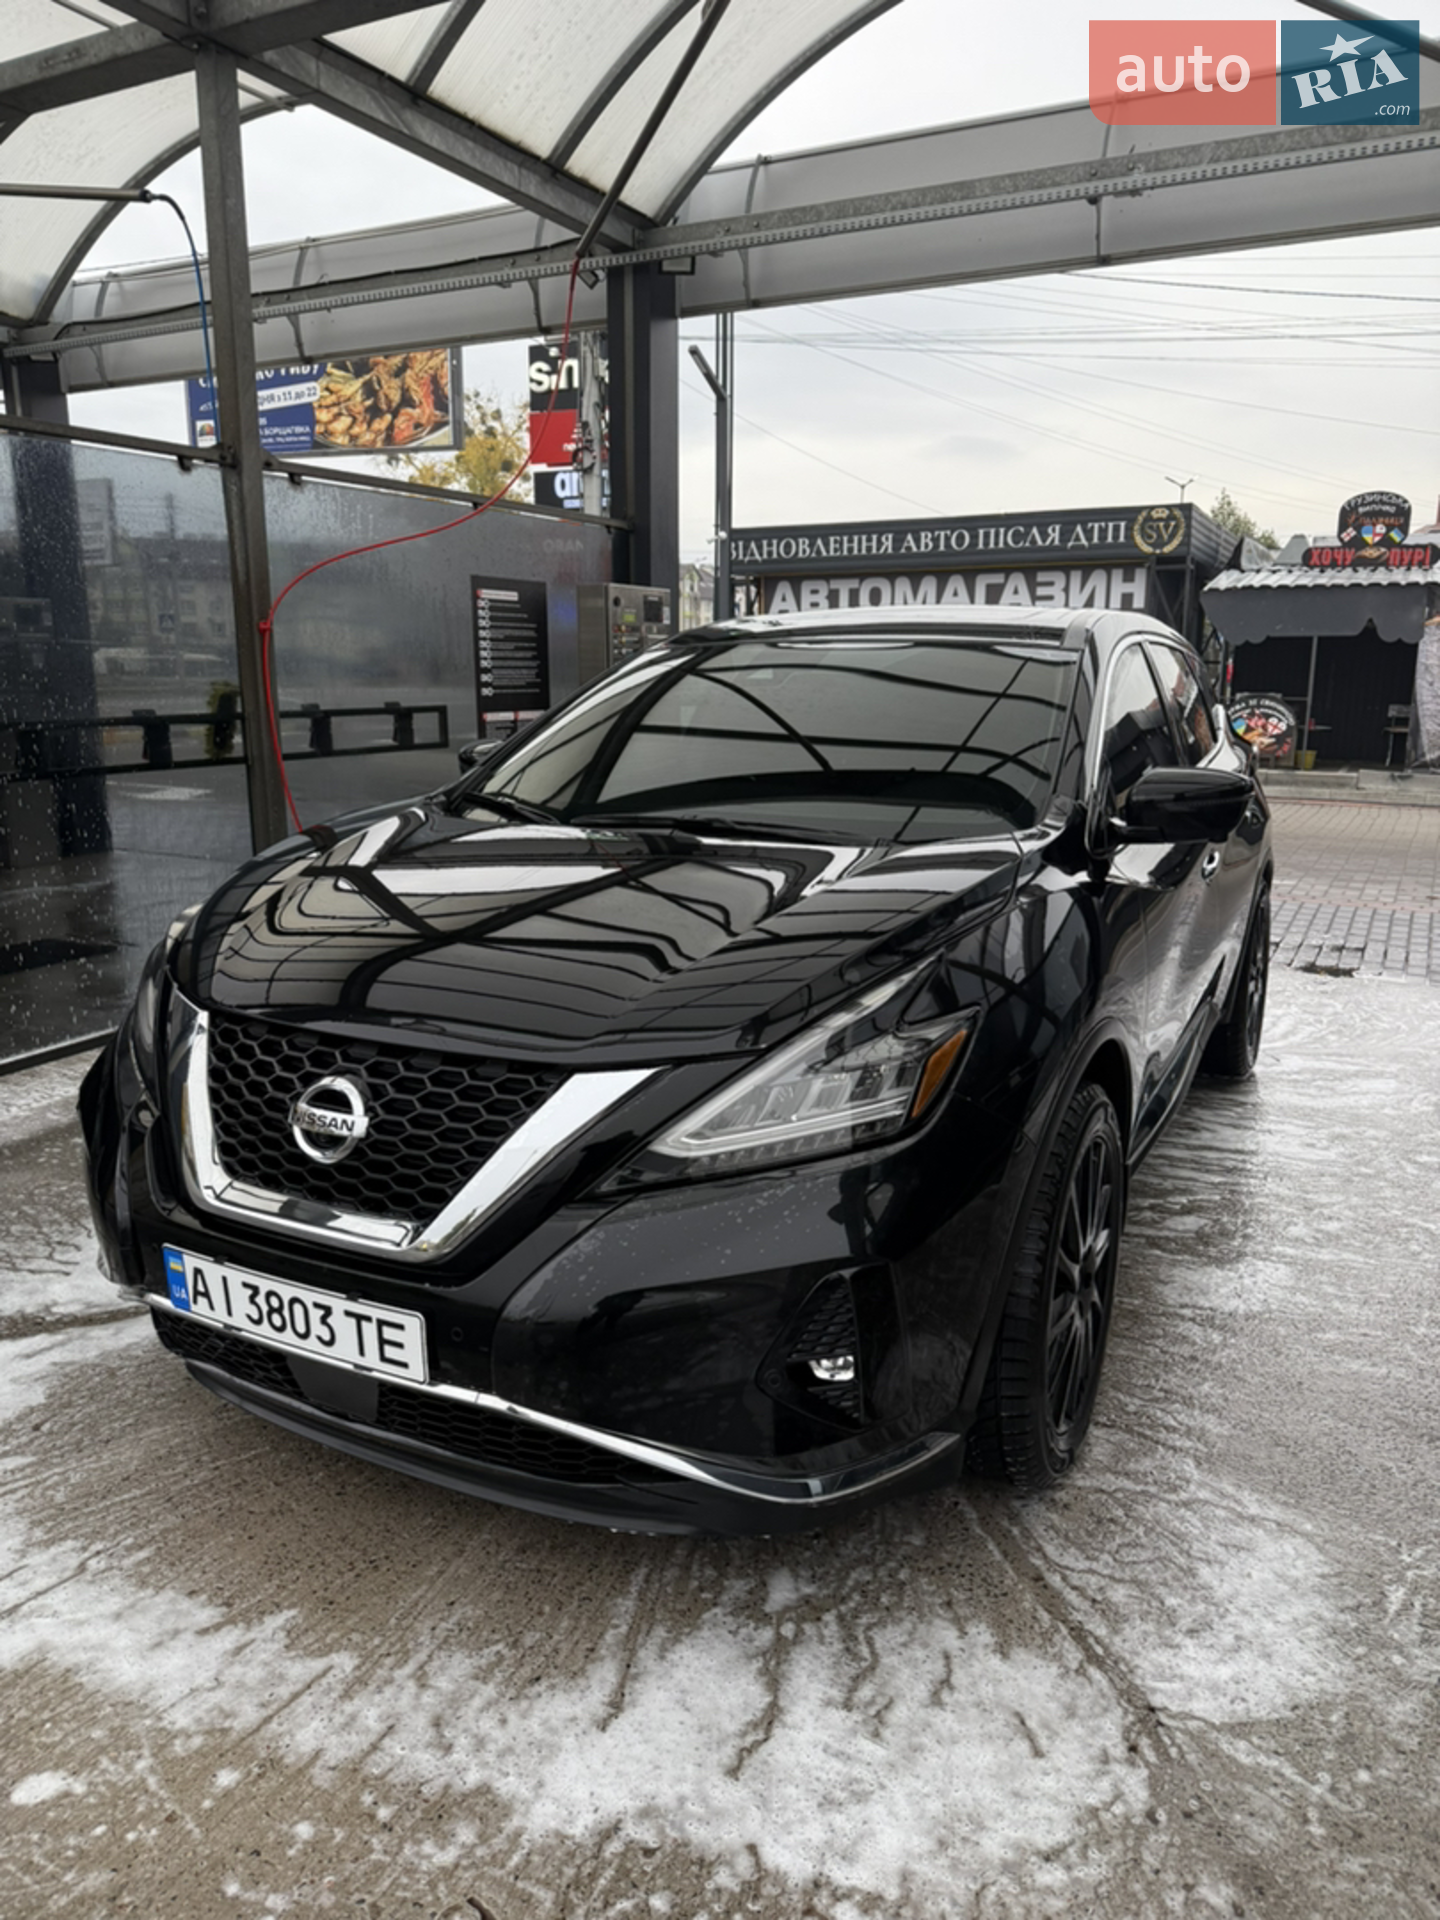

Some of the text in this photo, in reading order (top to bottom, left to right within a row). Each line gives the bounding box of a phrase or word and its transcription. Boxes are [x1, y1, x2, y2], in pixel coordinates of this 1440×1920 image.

[306, 385, 318, 398] 22
[900, 528, 971, 553] АВТО
[976, 523, 1063, 550] ПІСЛЯ
[1067, 520, 1128, 549] ДТП
[1143, 520, 1177, 544] SV
[1309, 545, 1432, 569] ХОЧУ ПУРІ
[767, 566, 1148, 615] АВТОМАГАЗИН
[294, 1108, 356, 1133] NISSAN
[173, 1285, 188, 1299] UA
[241, 1281, 337, 1348] 3803
[344, 1309, 410, 1370] TE
